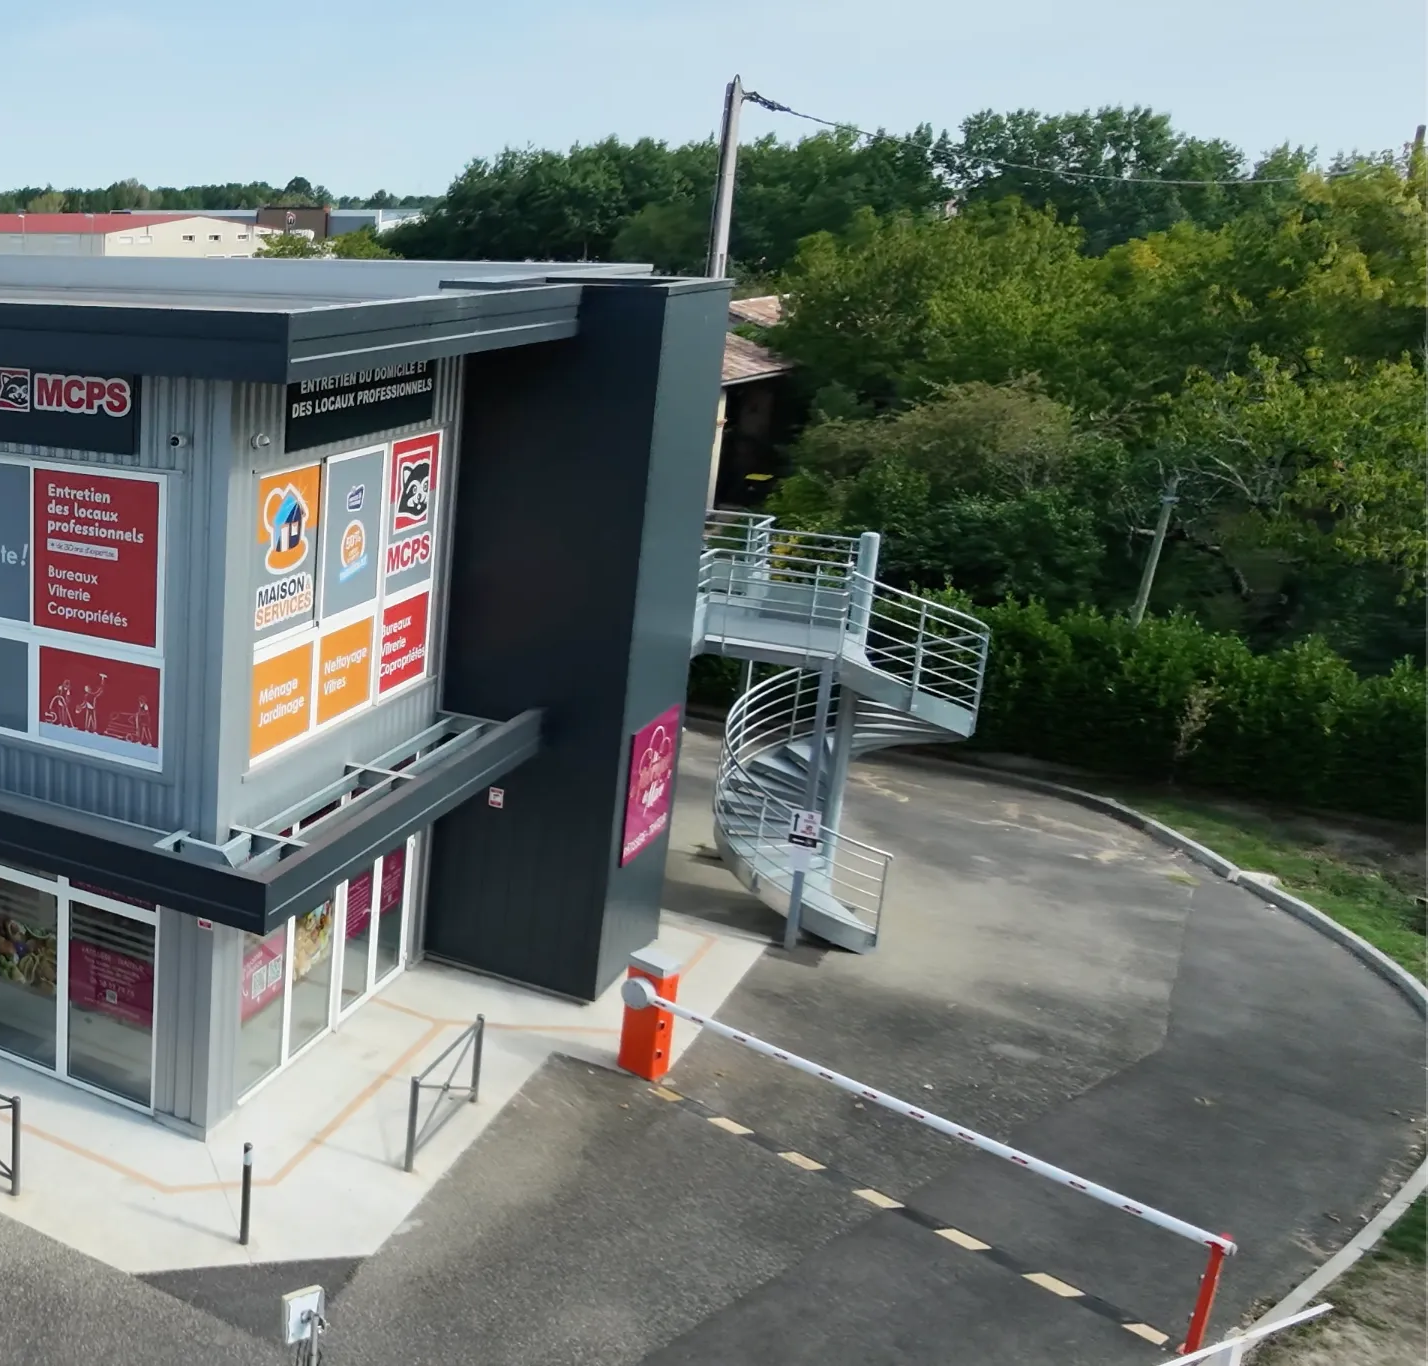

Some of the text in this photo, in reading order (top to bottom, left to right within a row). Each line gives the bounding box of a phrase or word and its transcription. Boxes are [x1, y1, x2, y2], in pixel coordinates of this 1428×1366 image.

[301, 360, 428, 394] ENTRETIEN DU DOMICILE ET
[36, 377, 128, 413] MCPS
[292, 377, 433, 419] DES LOCAUX PROFESSIONNELS
[47, 483, 111, 504] Entretien
[47, 500, 119, 522] des locaux
[47, 519, 144, 544] professionnels
[386, 534, 430, 575] MCPS
[48, 564, 98, 585] Bureaux
[48, 583, 91, 602] Vitrerie
[257, 575, 305, 608] MAISON
[47, 601, 128, 627] Copropriétés
[255, 591, 312, 627] SERVICES
[324, 647, 367, 675] Nettoyage
[258, 678, 299, 705] Ménage
[324, 676, 346, 695] Vitres
[258, 695, 305, 727] Jardinage
